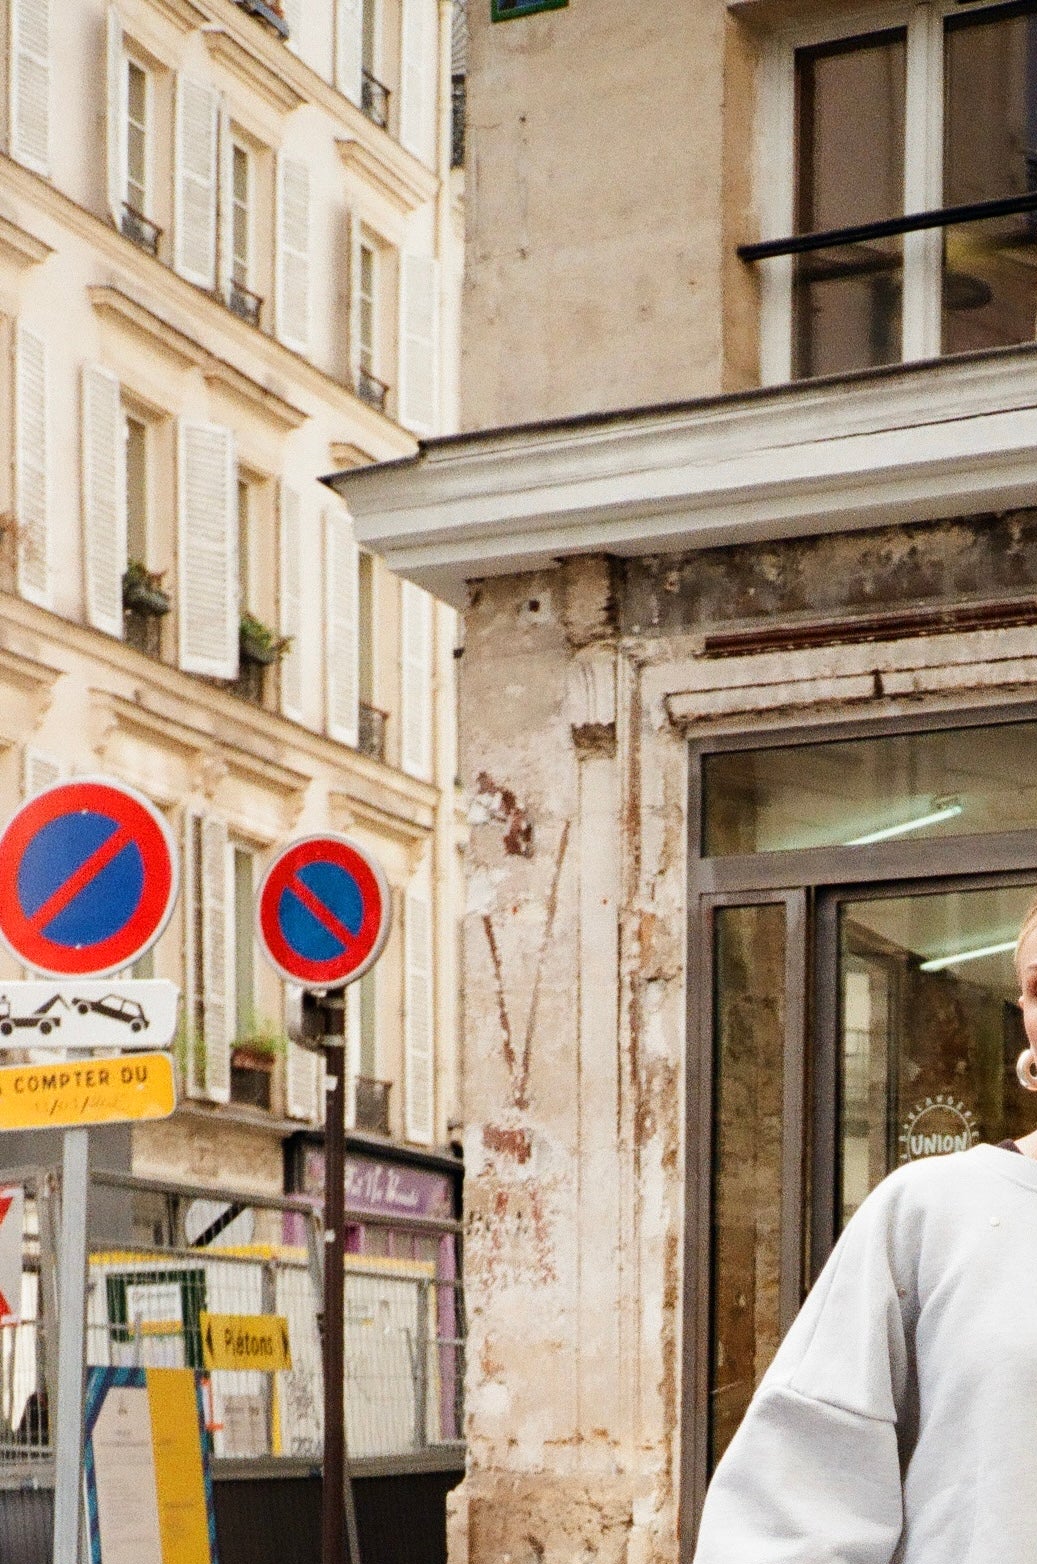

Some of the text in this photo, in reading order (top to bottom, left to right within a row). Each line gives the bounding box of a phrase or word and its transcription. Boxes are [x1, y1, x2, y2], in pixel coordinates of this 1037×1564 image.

[14, 1066, 110, 1094] COMPTER
[120, 1065, 148, 1084] DU
[910, 1131, 968, 1155] UNION
